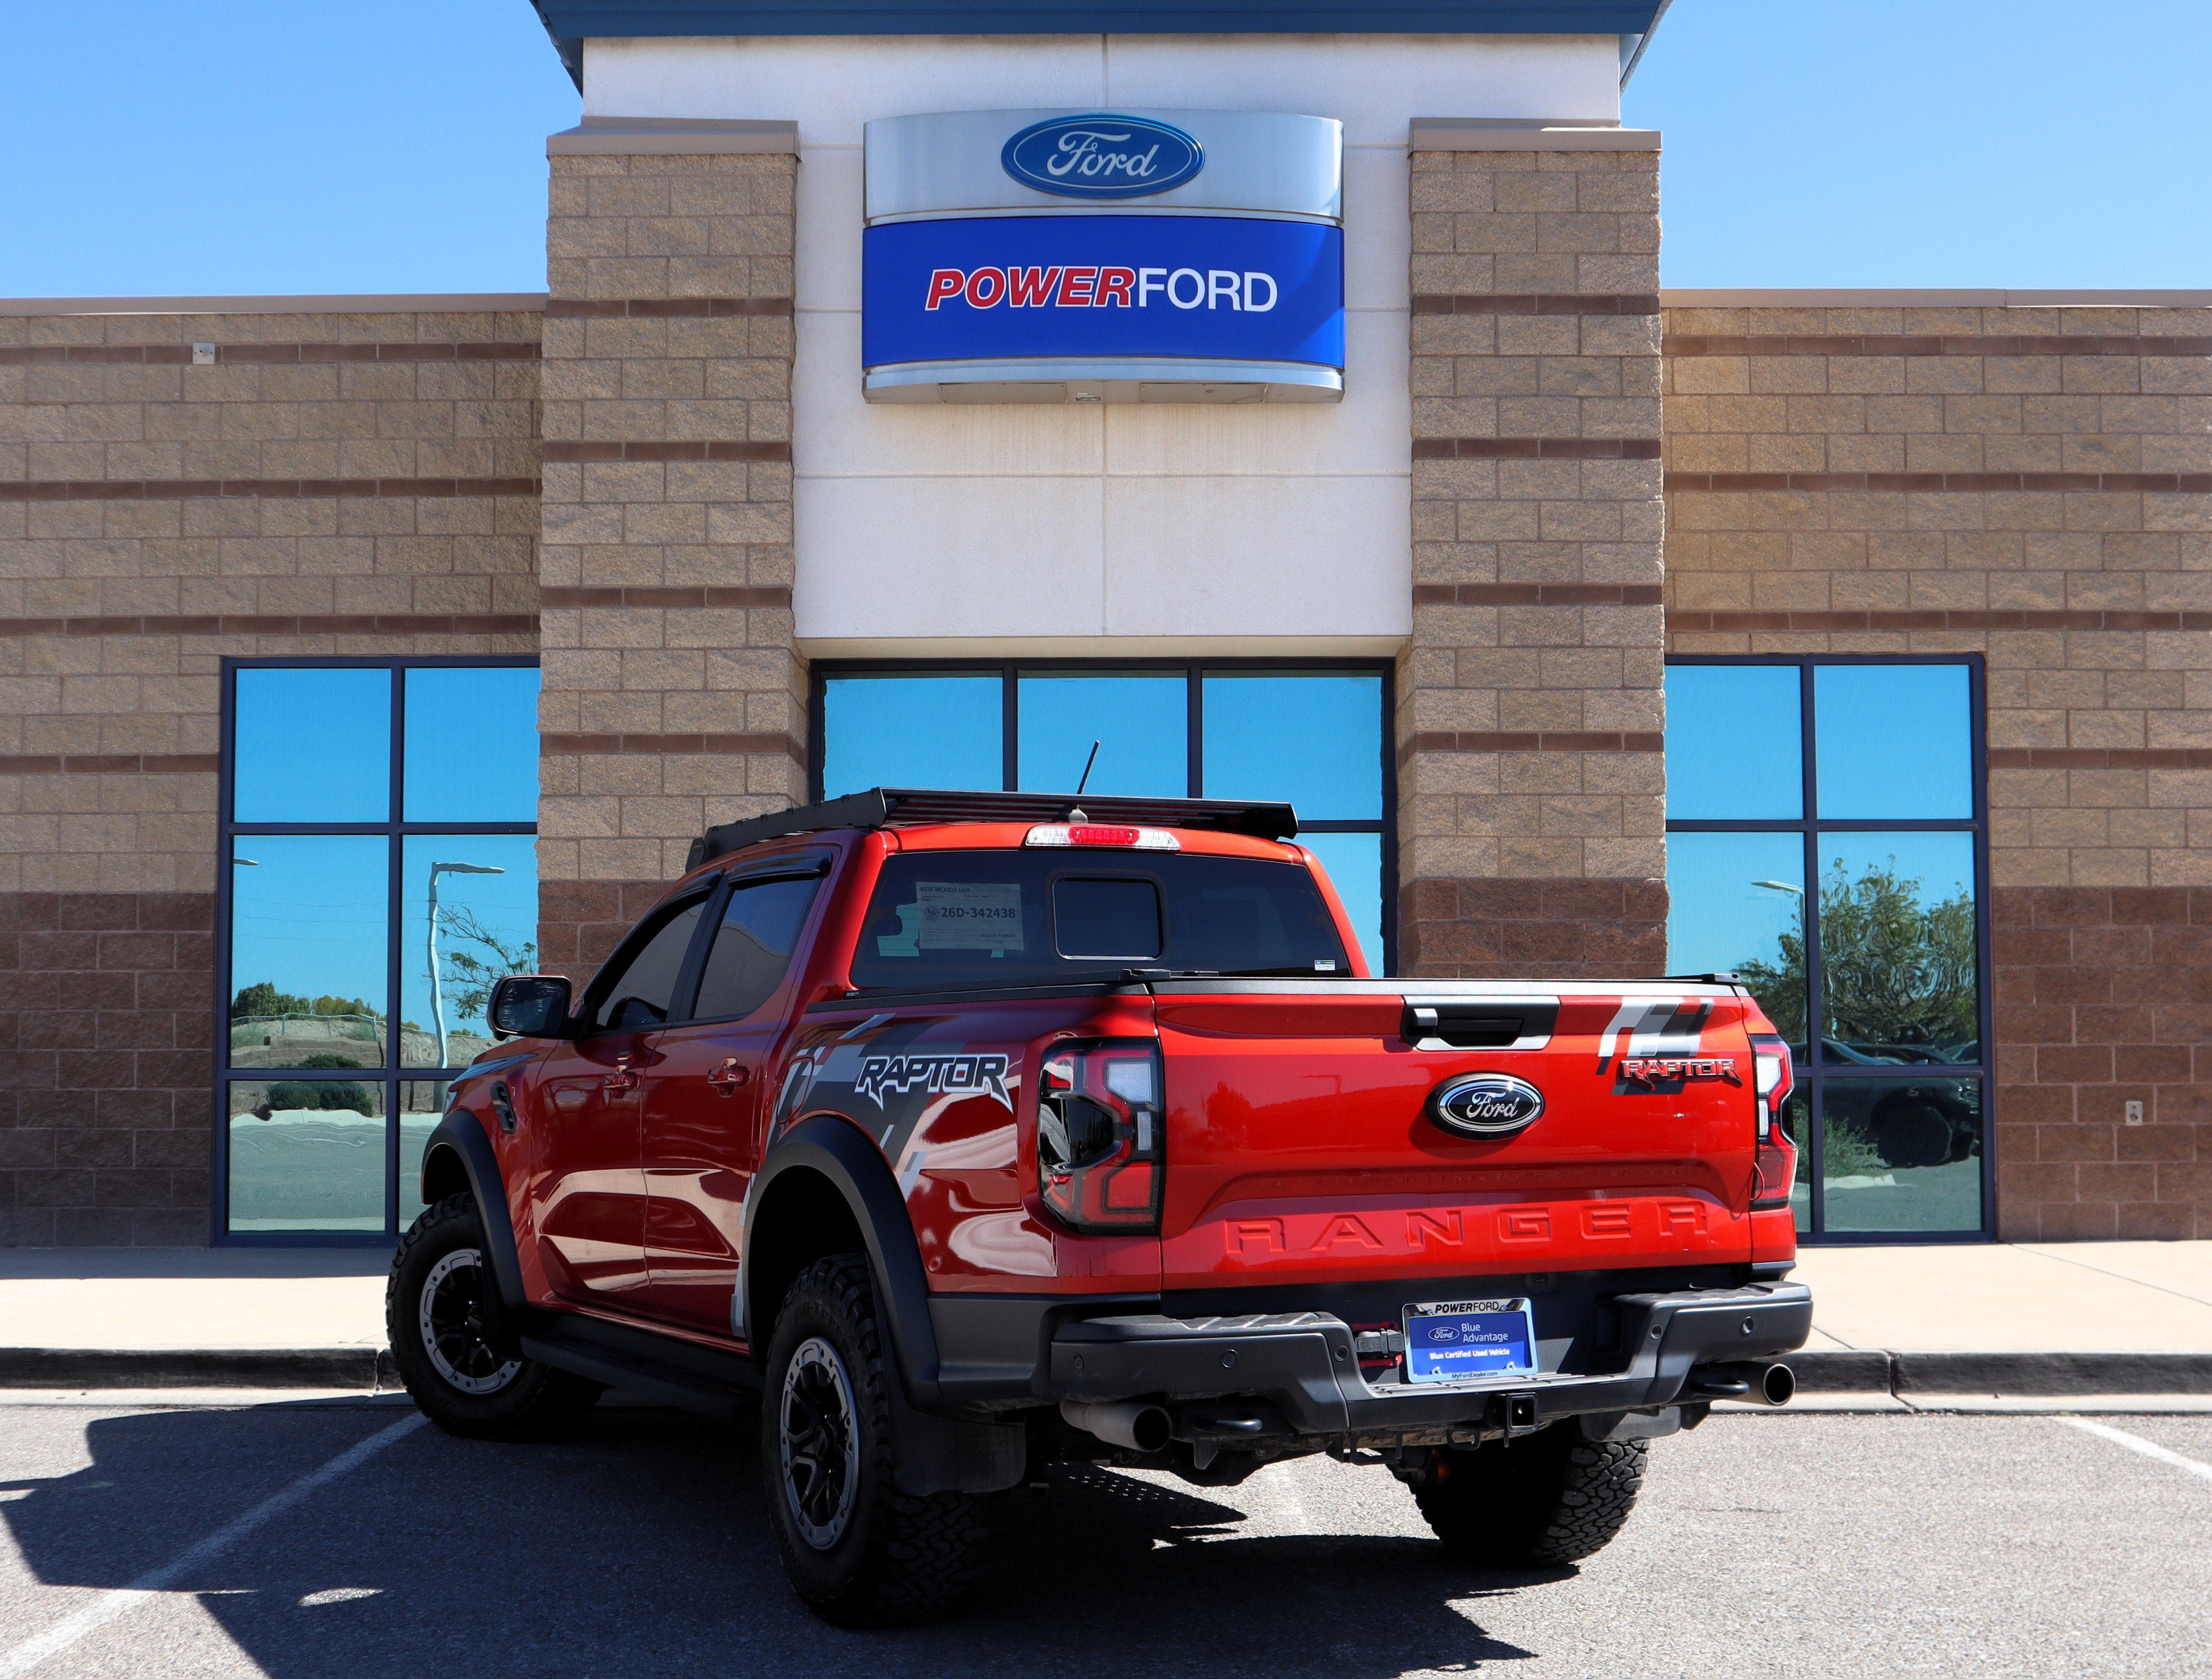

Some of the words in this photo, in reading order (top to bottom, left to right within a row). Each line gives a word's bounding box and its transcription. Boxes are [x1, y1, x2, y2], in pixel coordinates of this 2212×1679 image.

[1047, 130, 1160, 177] Ford
[925, 265, 1278, 312] POWERFORD
[941, 907, 1016, 919] 26D-342438
[854, 1053, 1014, 1113] RAPTOR
[1621, 1058, 1743, 1090] RAPTOR
[1466, 1091, 1519, 1119] Ford
[1224, 1201, 1708, 1255] RANGER
[1436, 1301, 1499, 1314] POWERFORD
[1434, 1329, 1454, 1339] Ford
[1462, 1323, 1481, 1332] Blue
[1463, 1332, 1508, 1343] Advantage
